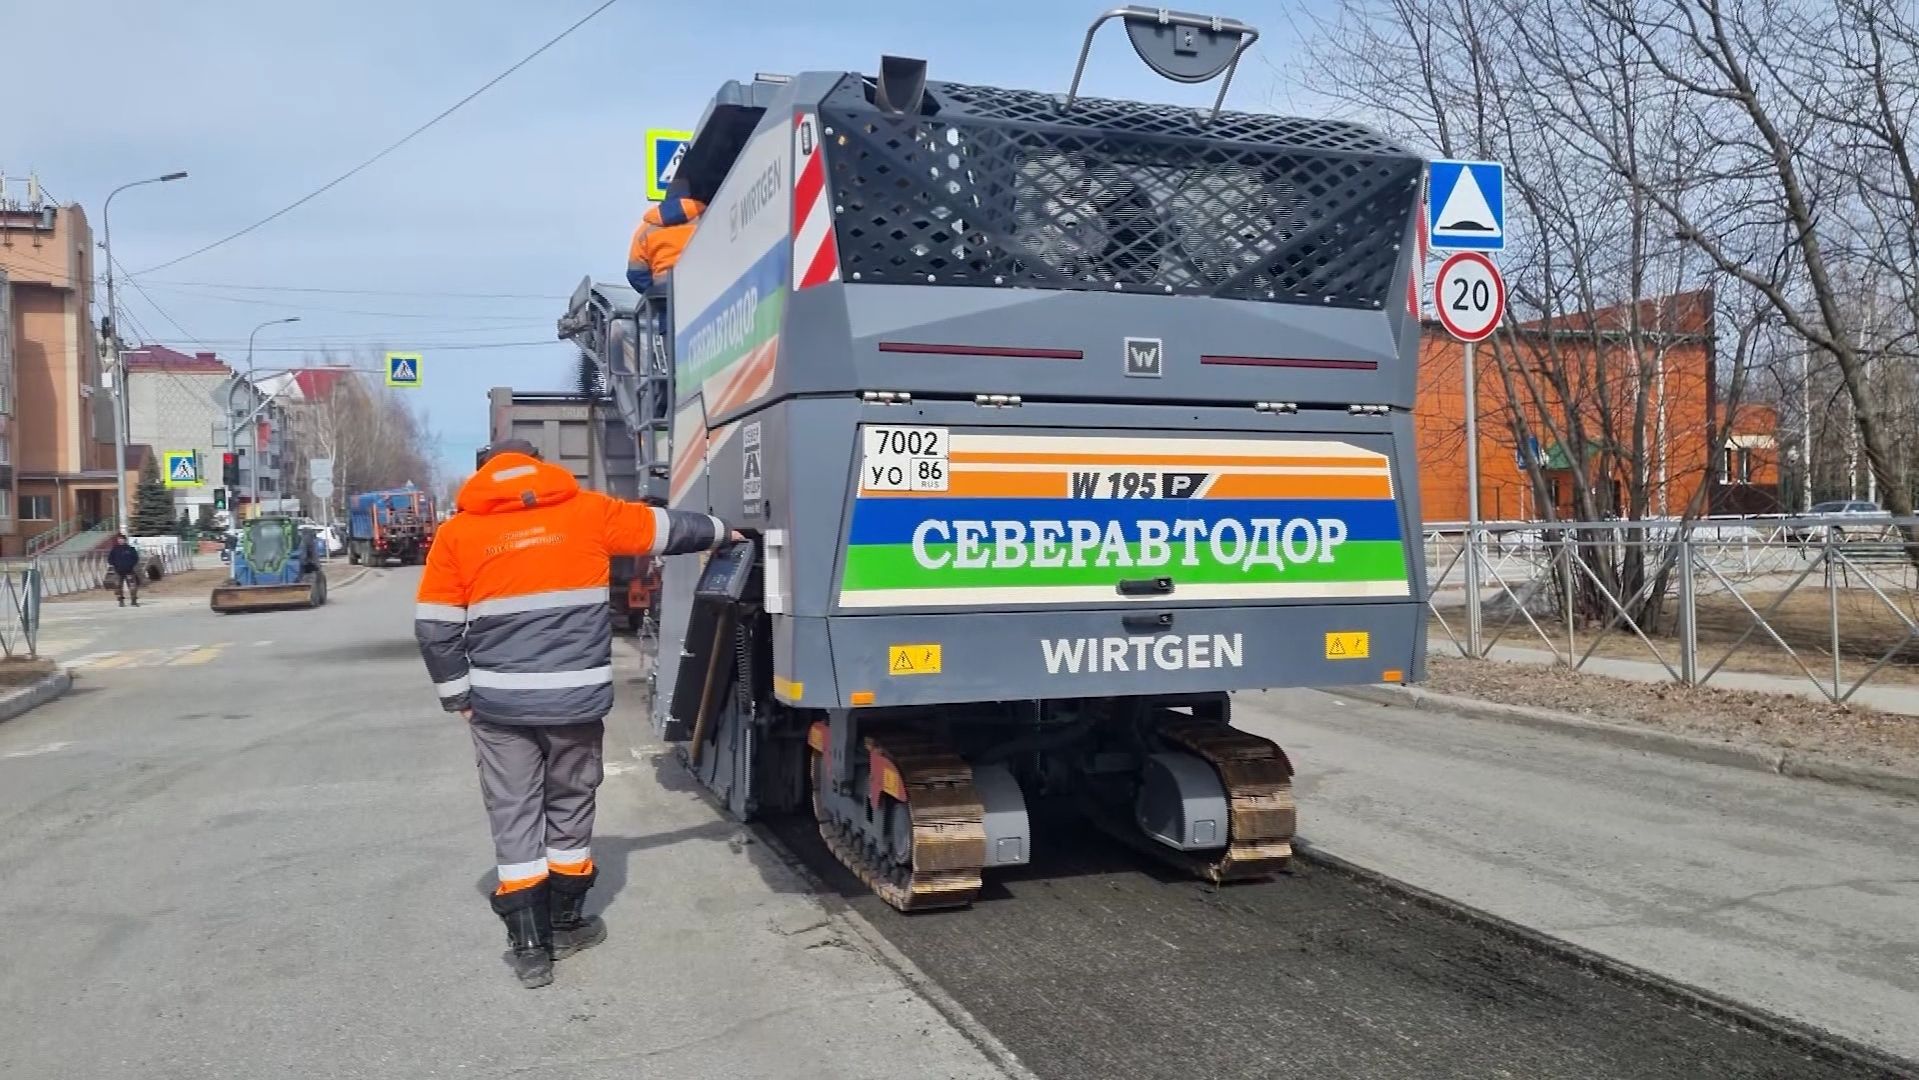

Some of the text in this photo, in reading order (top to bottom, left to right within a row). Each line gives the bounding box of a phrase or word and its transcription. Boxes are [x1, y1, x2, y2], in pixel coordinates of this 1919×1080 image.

[740, 157, 781, 228] WIRTGEN
[1453, 278, 1489, 312] 20
[875, 430, 938, 455] 7002
[872, 461, 942, 485] УО 86
[1072, 472, 1100, 499] W
[1108, 472, 1156, 499] 195
[912, 517, 1348, 572] СЕВЕРАВТОДОР
[1041, 633, 1243, 674] WIRTGEN
